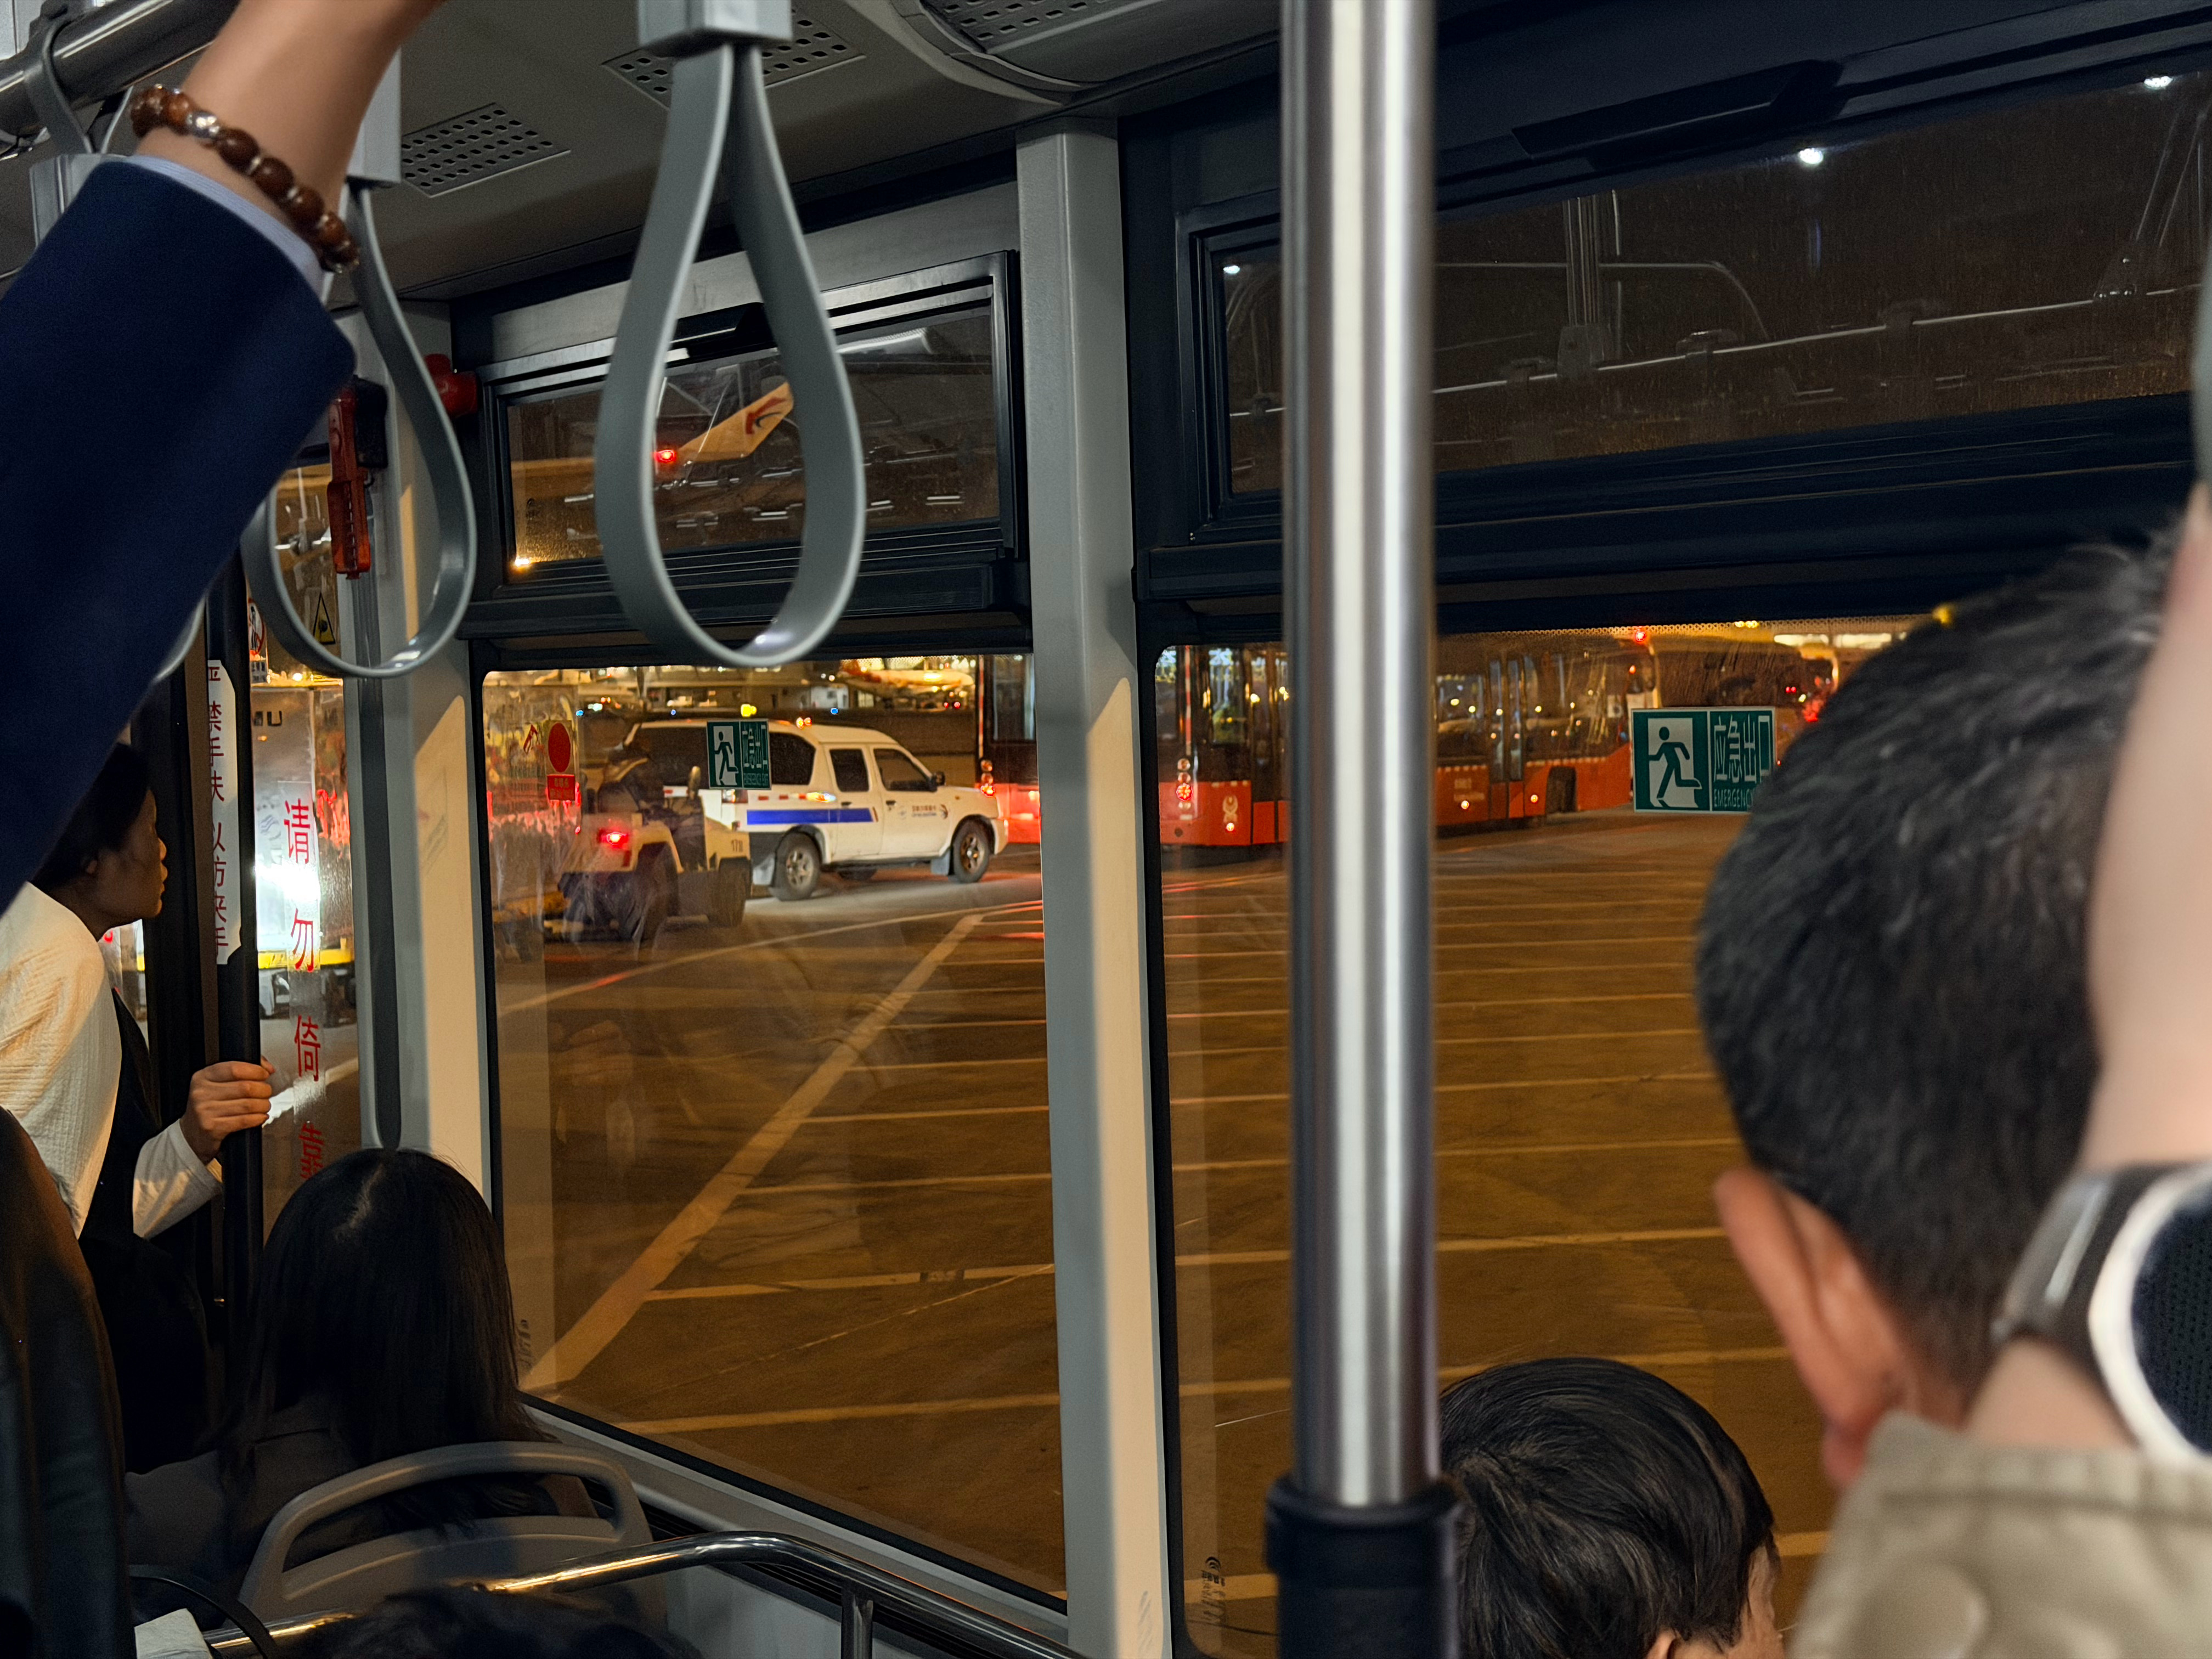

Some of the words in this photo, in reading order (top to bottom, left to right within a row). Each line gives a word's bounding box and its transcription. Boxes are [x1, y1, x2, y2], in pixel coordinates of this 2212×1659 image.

[742, 723, 768, 770] 应急出口
[1713, 713, 1771, 784] 应急出口
